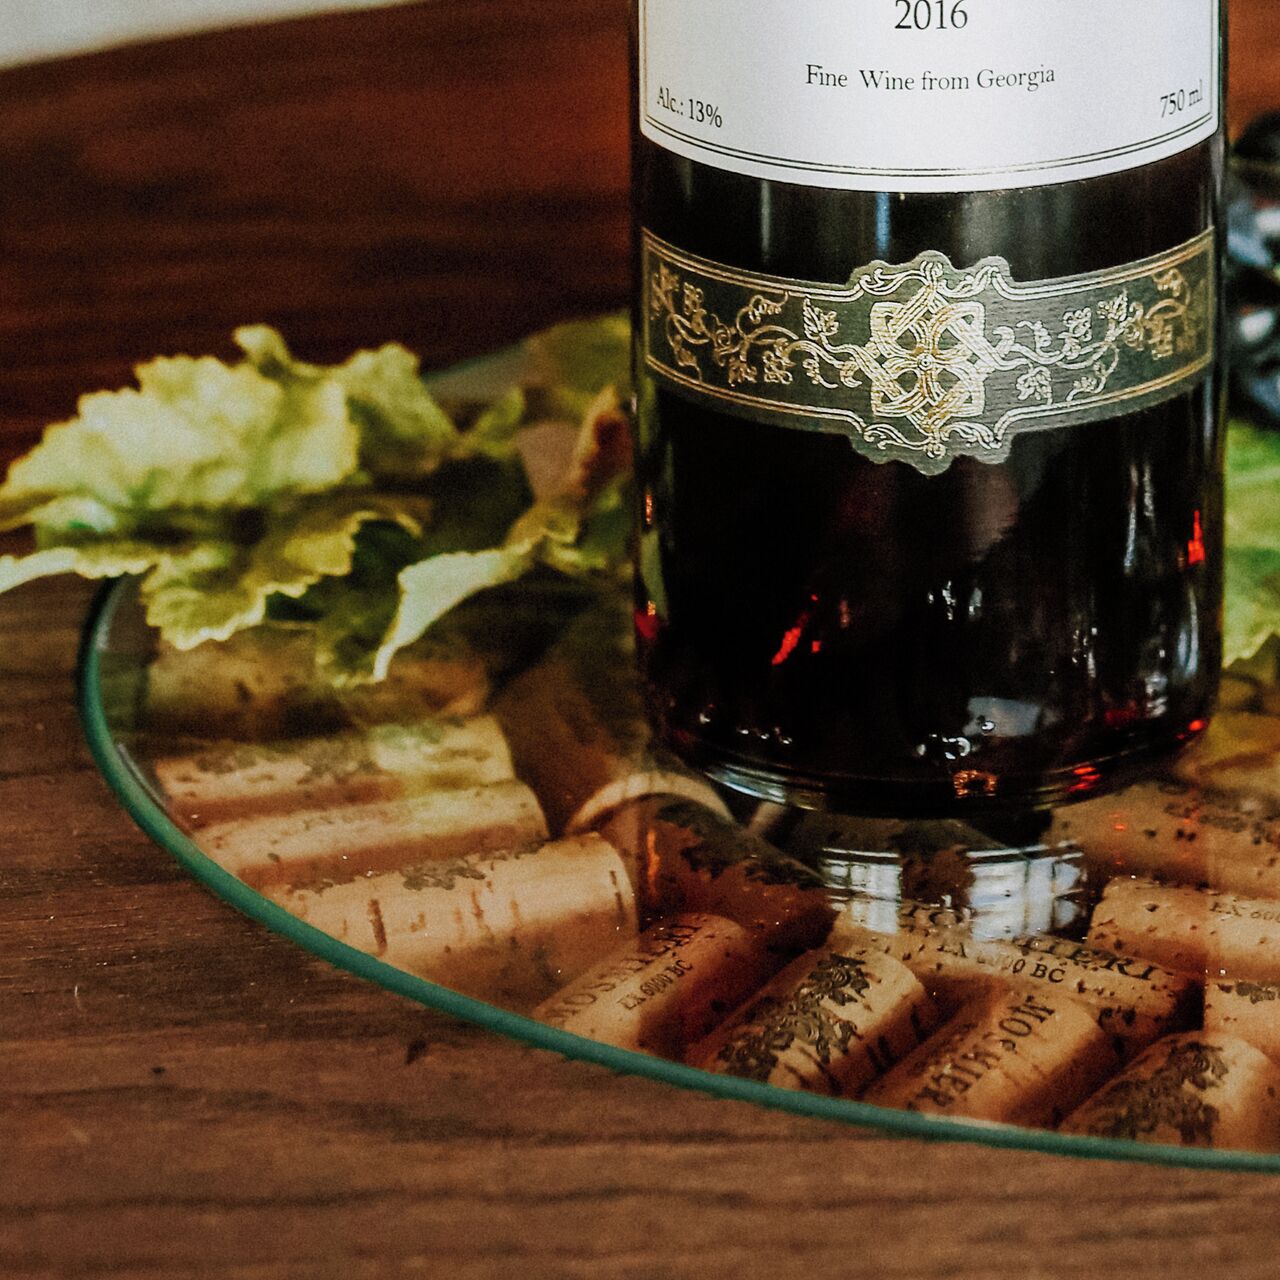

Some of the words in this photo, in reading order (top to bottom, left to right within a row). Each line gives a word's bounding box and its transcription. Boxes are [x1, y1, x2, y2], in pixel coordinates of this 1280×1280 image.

[805, 63, 848, 87] Fine
[859, 69, 915, 91] Wine
[921, 70, 969, 91] from
[977, 64, 1055, 92] Georgia
[689, 98, 723, 128] 13%
[1159, 88, 1185, 119] 750
[1030, 962, 1066, 984] BC
